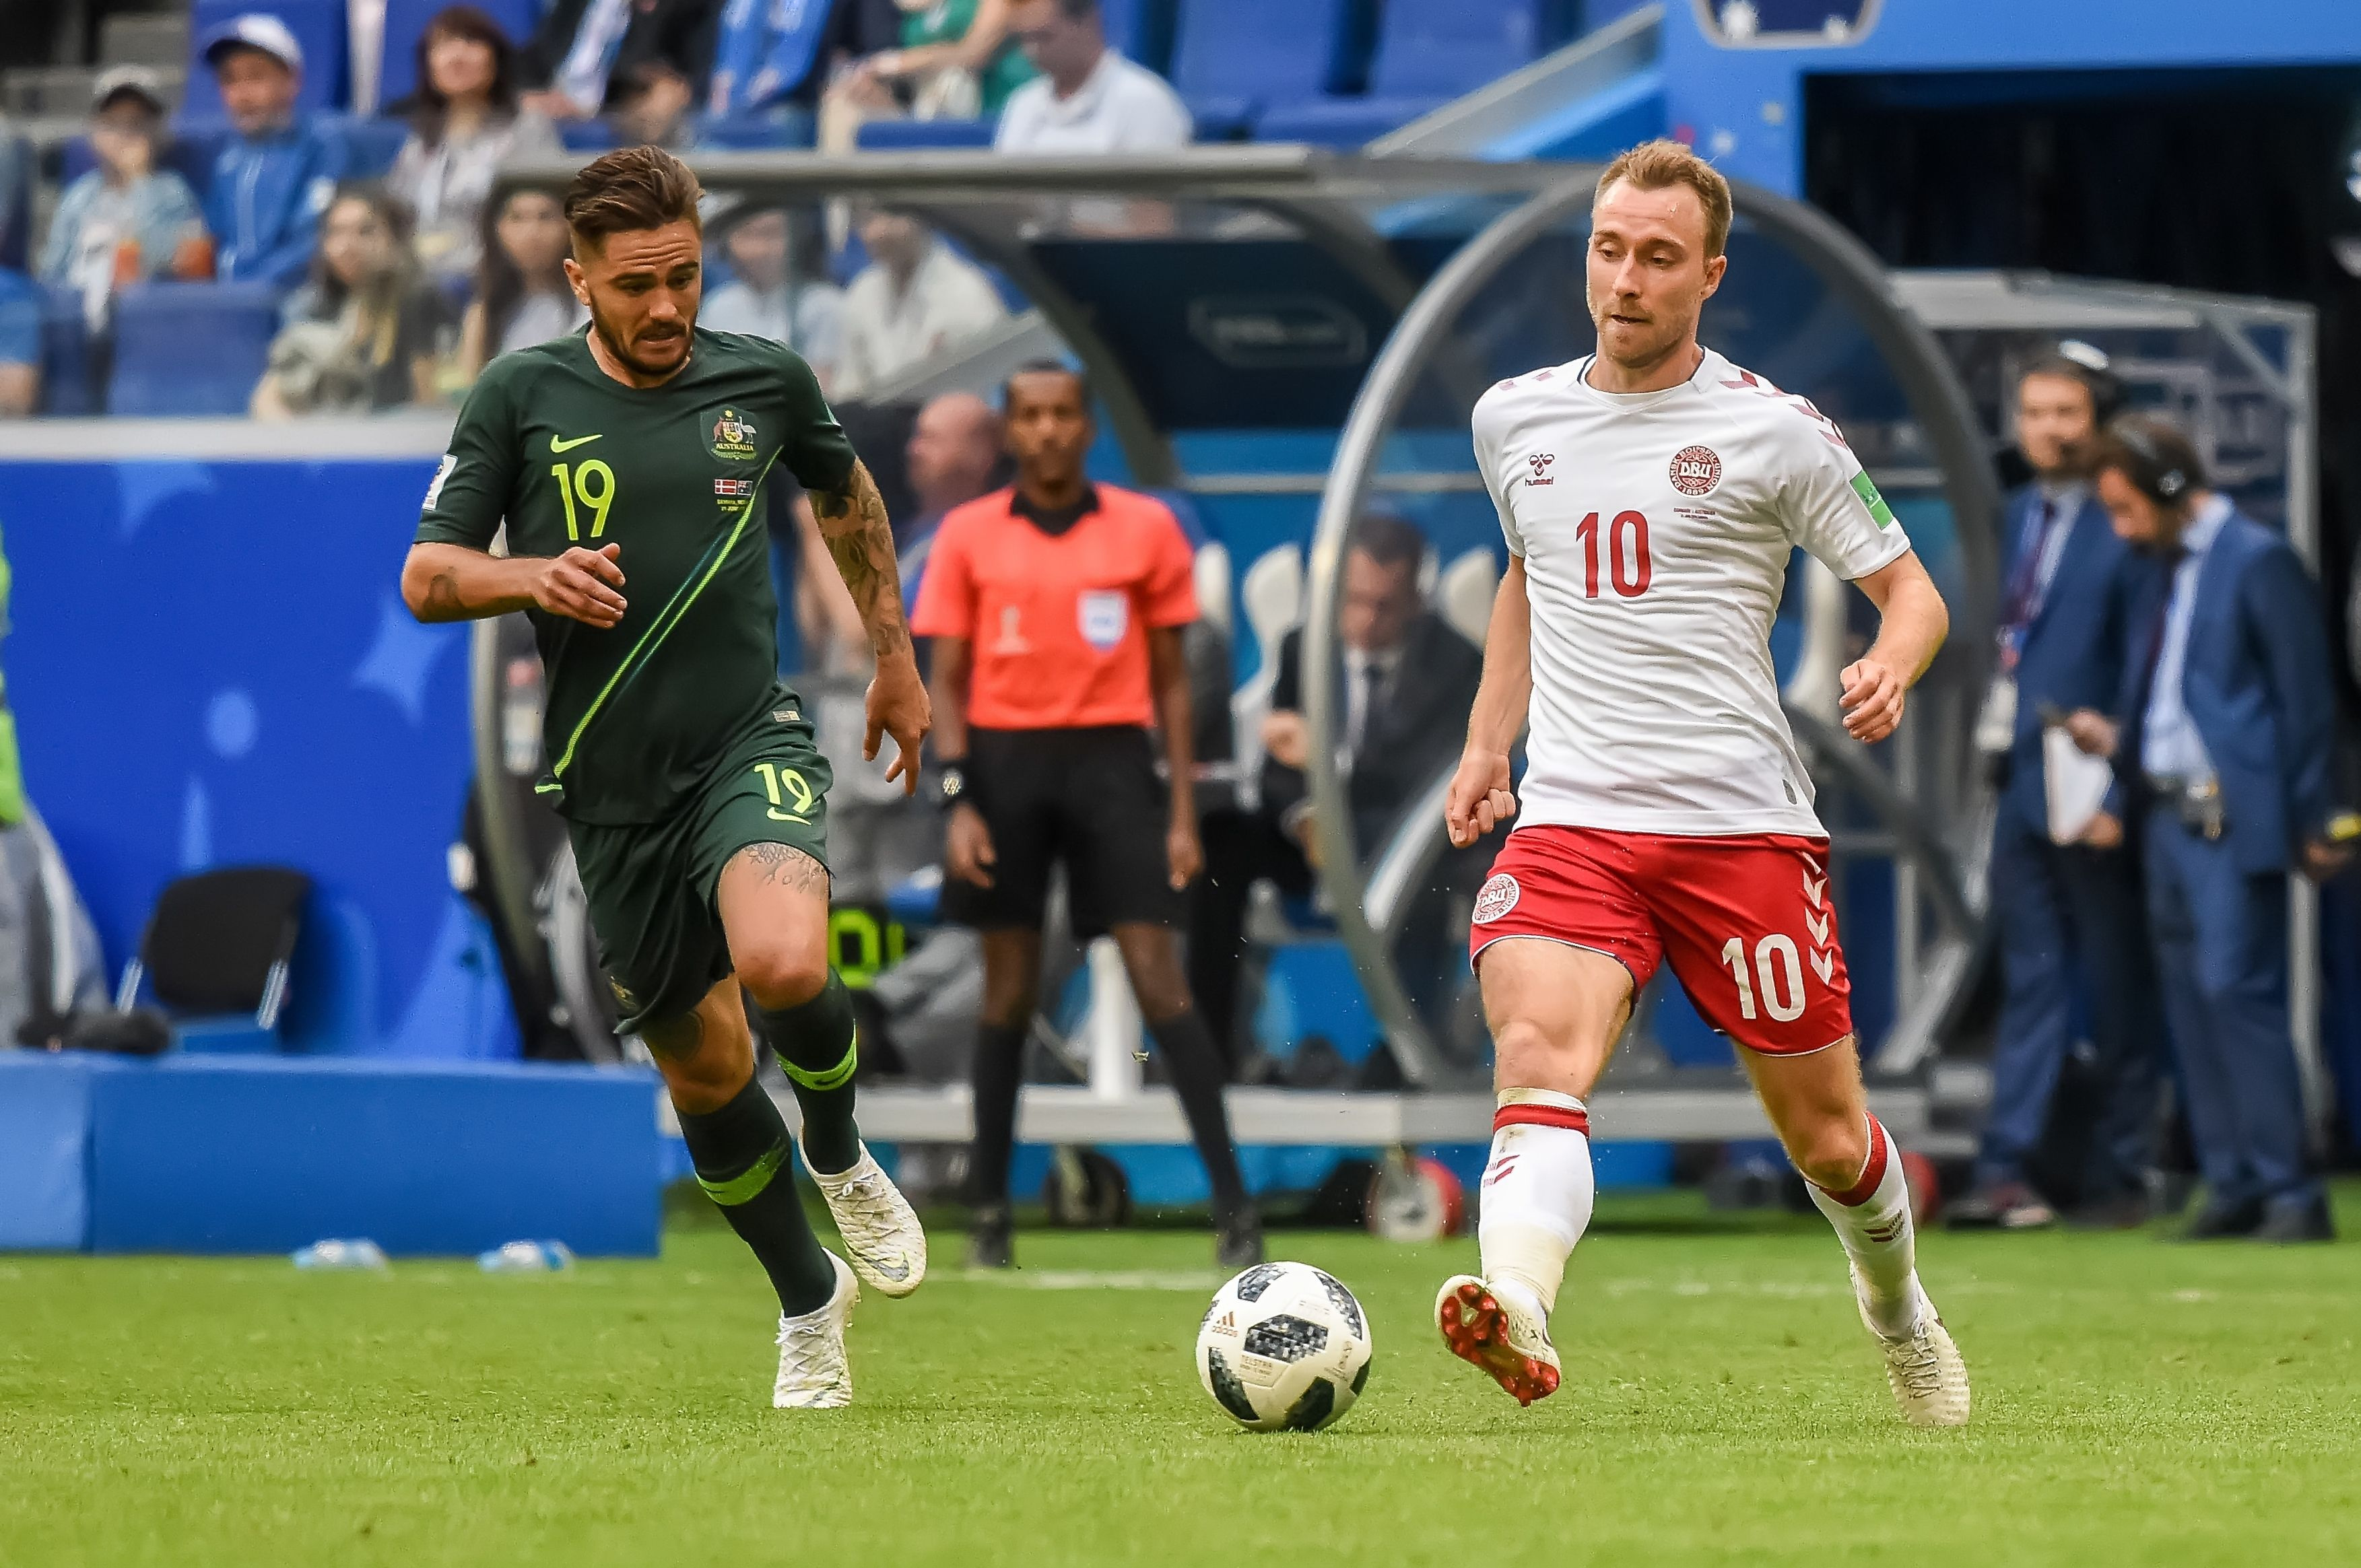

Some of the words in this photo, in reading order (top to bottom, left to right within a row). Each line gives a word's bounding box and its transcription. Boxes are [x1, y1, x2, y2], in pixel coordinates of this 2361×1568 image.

[715, 443, 754, 452] AUSTRALIA
[1525, 476, 1554, 486] hummel
[1678, 461, 1712, 479] DBU
[551, 459, 616, 541] 19
[1576, 510, 1652, 599] 10
[754, 763, 813, 814] 19
[1480, 887, 1508, 908] DBU
[1721, 934, 1806, 1022] 10
